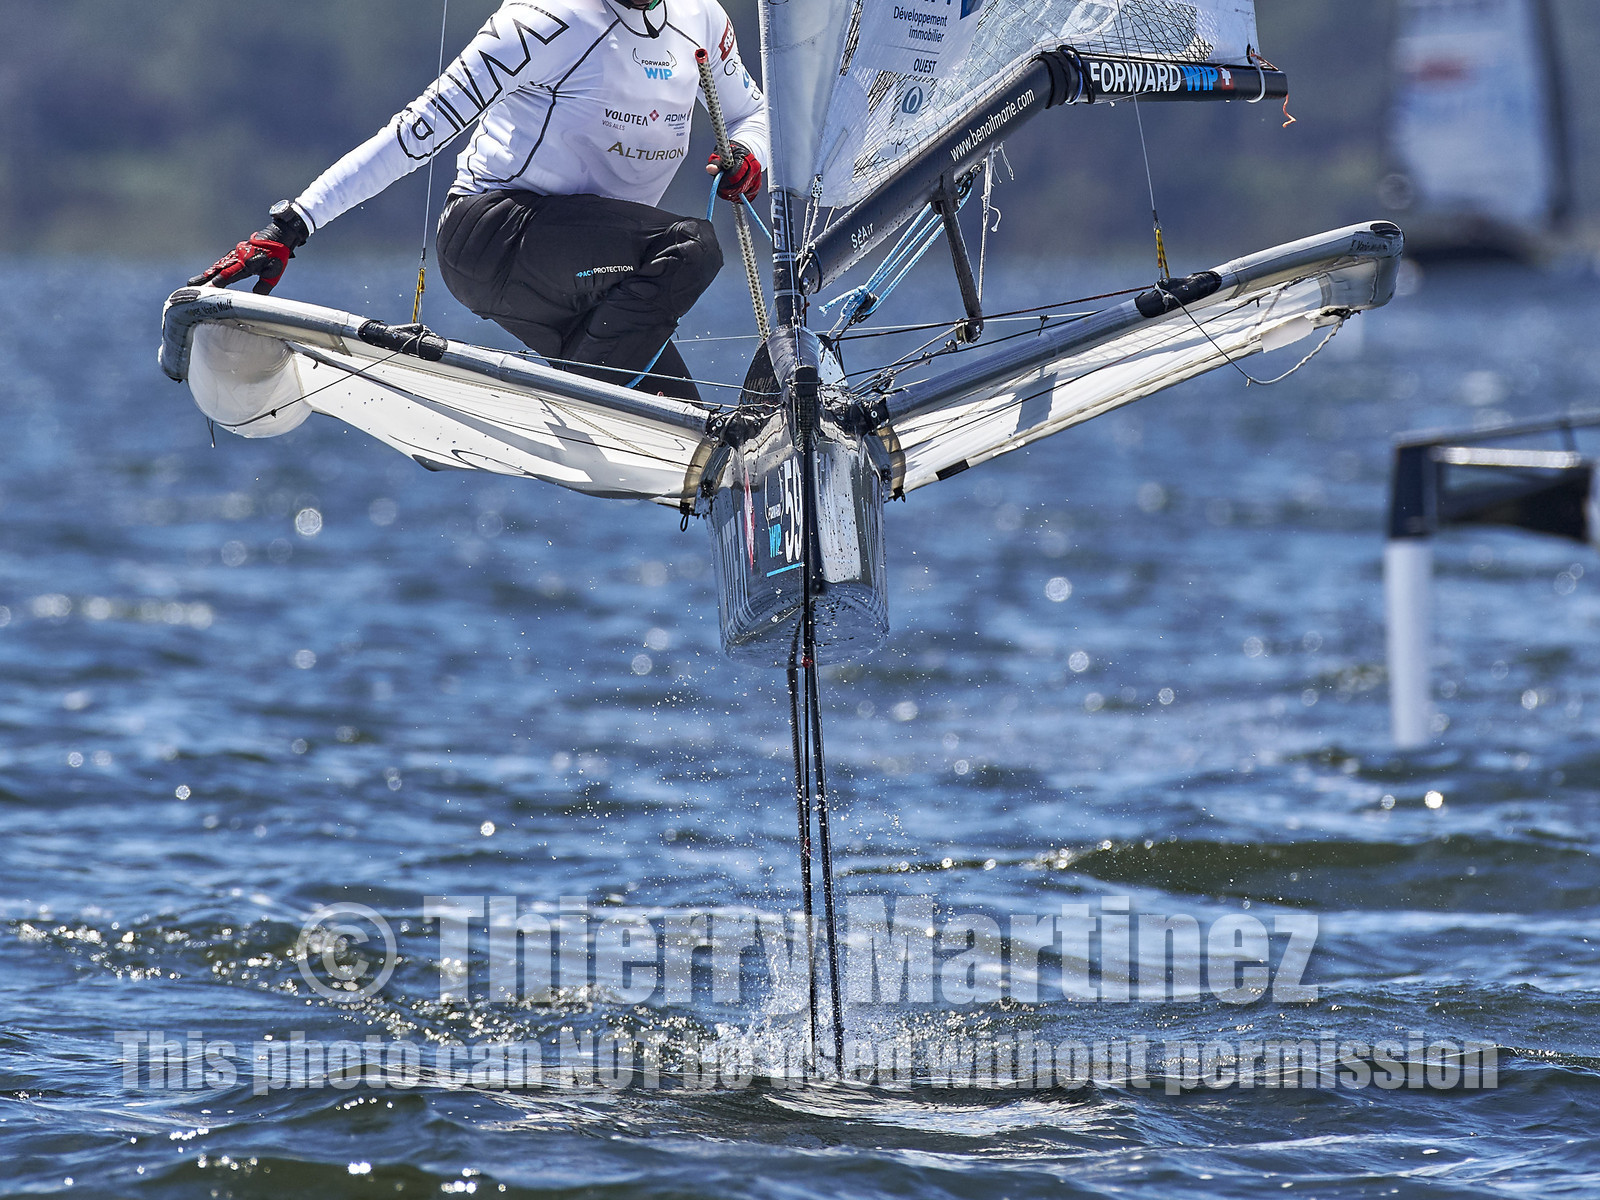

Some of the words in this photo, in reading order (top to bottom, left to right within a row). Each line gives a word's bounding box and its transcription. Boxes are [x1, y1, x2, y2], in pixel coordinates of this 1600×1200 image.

[893, 5, 948, 27] Développement
[908, 25, 945, 43] immobilier
[641, 59, 671, 67] FORWARD
[913, 58, 938, 75] OUEST
[644, 67, 673, 81] WIP
[604, 108, 649, 127] VOLOTEA
[664, 112, 687, 123] ADIM
[950, 88, 1036, 162] www.benoitmarie.com
[607, 141, 684, 161] ALTURION
[592, 265, 634, 275] PROTECTION
